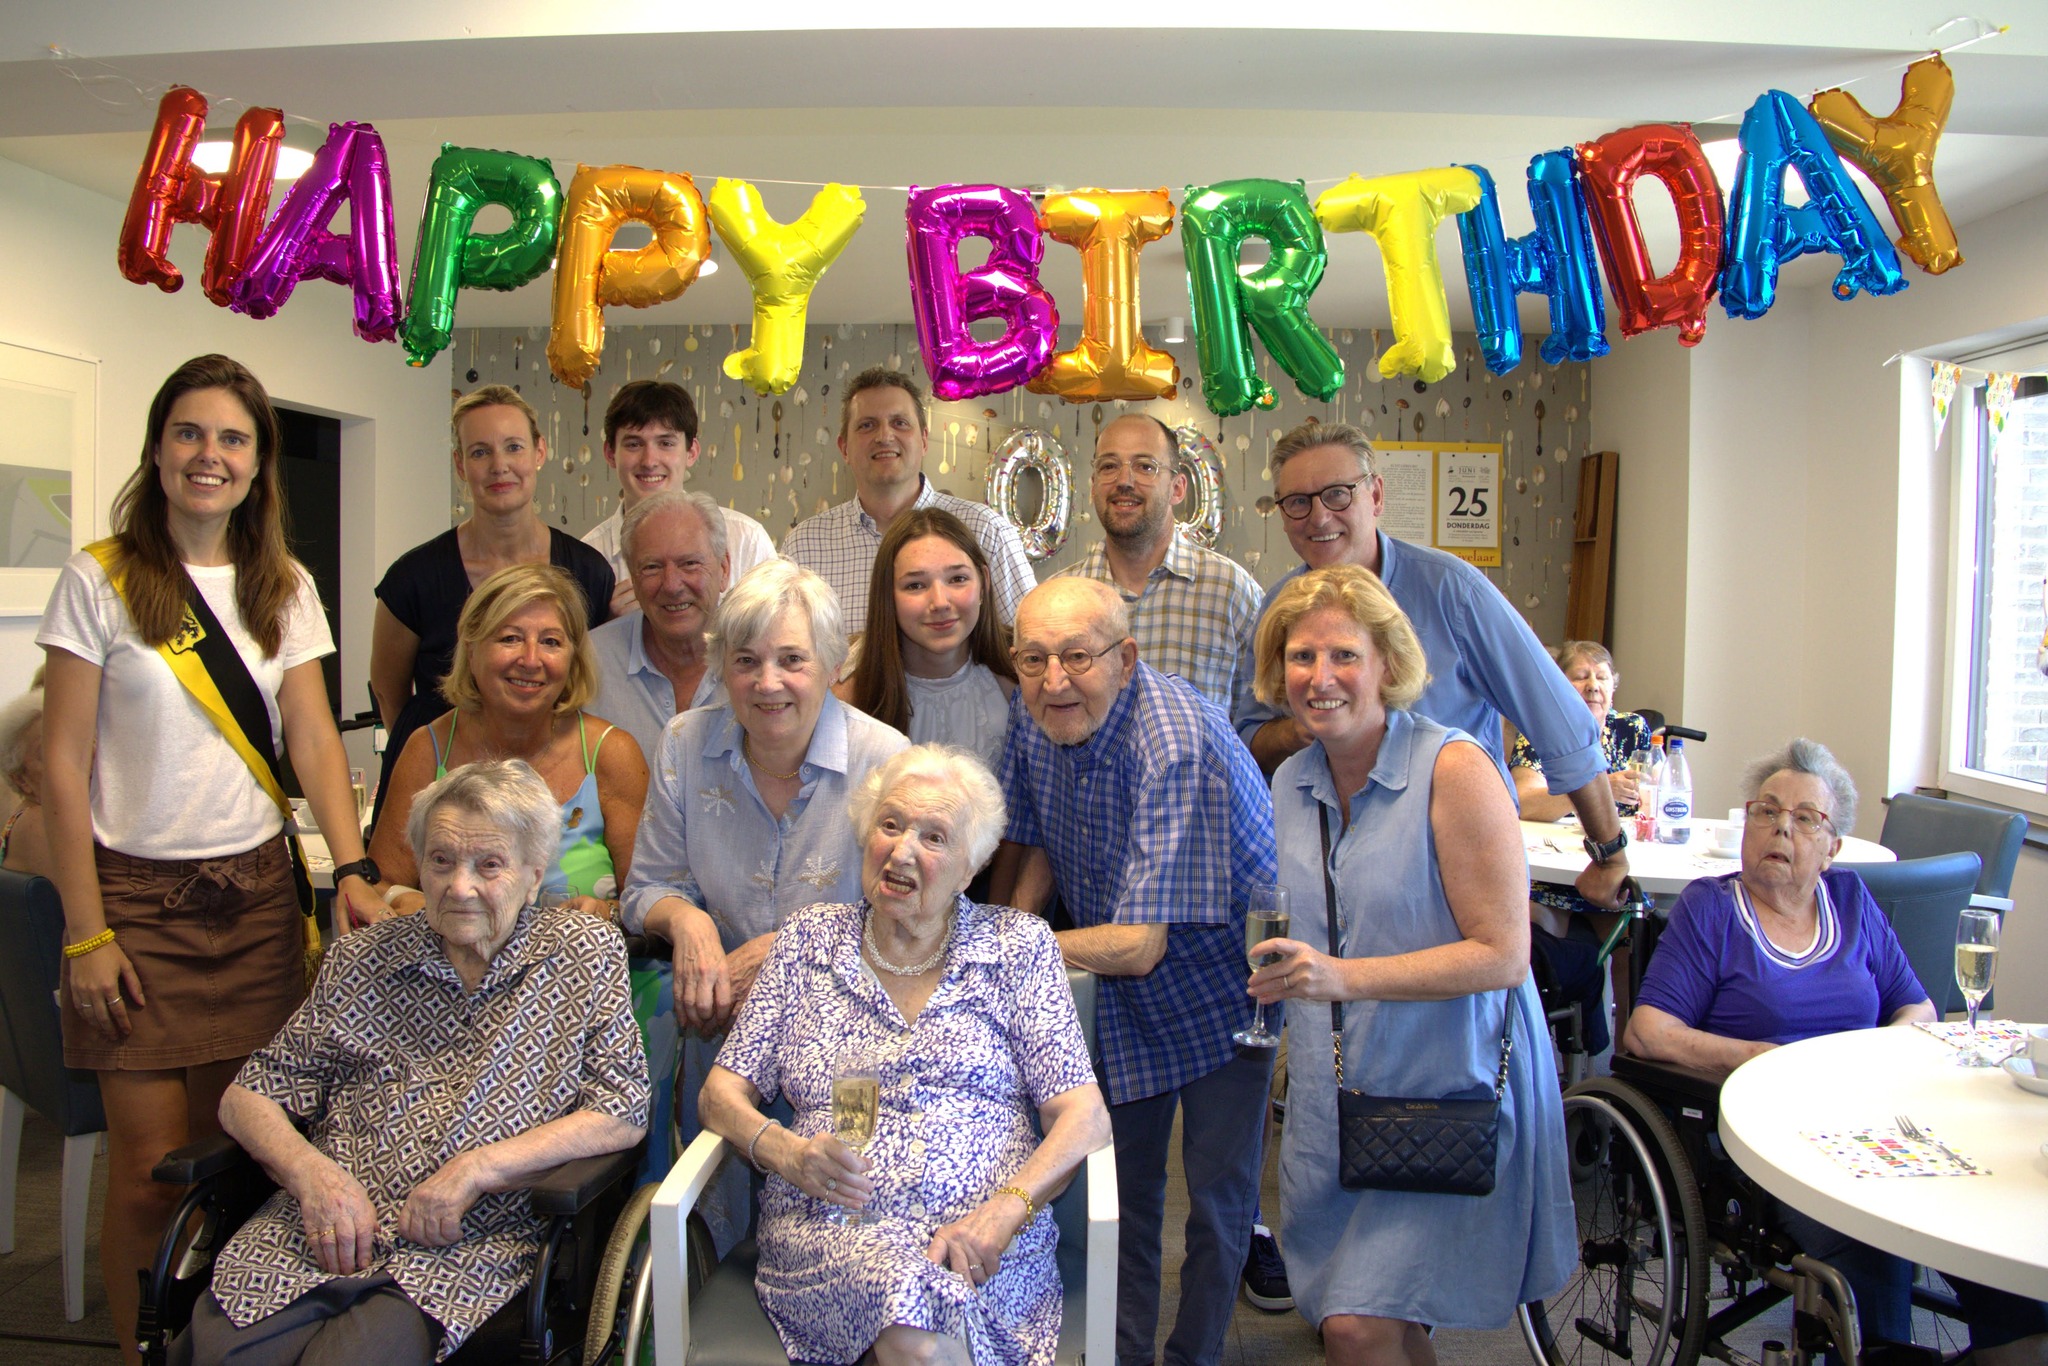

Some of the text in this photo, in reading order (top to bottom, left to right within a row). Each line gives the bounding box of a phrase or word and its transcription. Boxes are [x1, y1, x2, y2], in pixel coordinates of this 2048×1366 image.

[118, 52, 1963, 416] HAPPY BIRTHDAY
[1448, 486, 1489, 517] 25
[1457, 549, 1495, 562] ivelaar
[1852, 1135, 1912, 1168] BIRTHDAY
[1878, 1138, 1924, 1163] HAPPY
